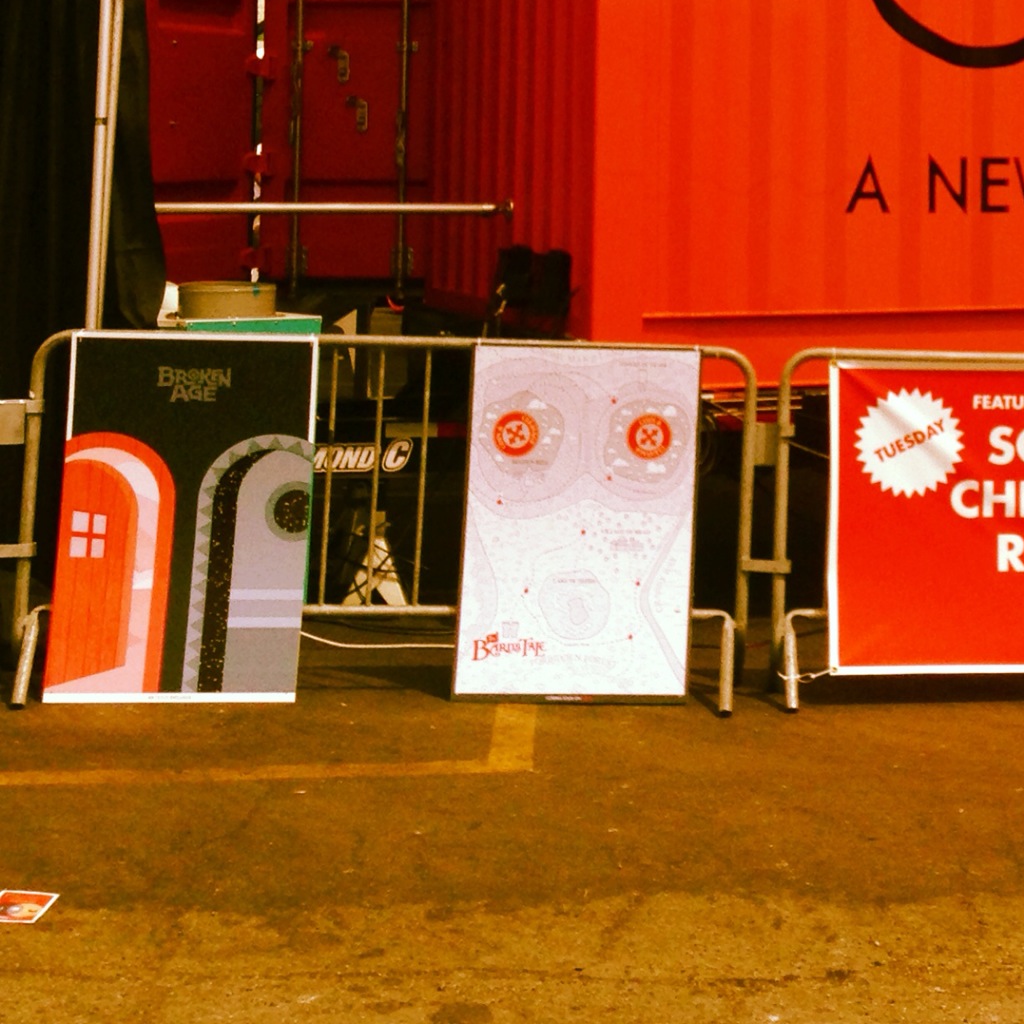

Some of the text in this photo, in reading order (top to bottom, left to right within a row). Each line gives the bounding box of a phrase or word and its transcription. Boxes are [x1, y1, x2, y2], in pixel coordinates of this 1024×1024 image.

[845, 153, 891, 215] A
[157, 366, 232, 388] BROKEN
[169, 384, 218, 403] AGE
[873, 417, 946, 463] TUESDAY
